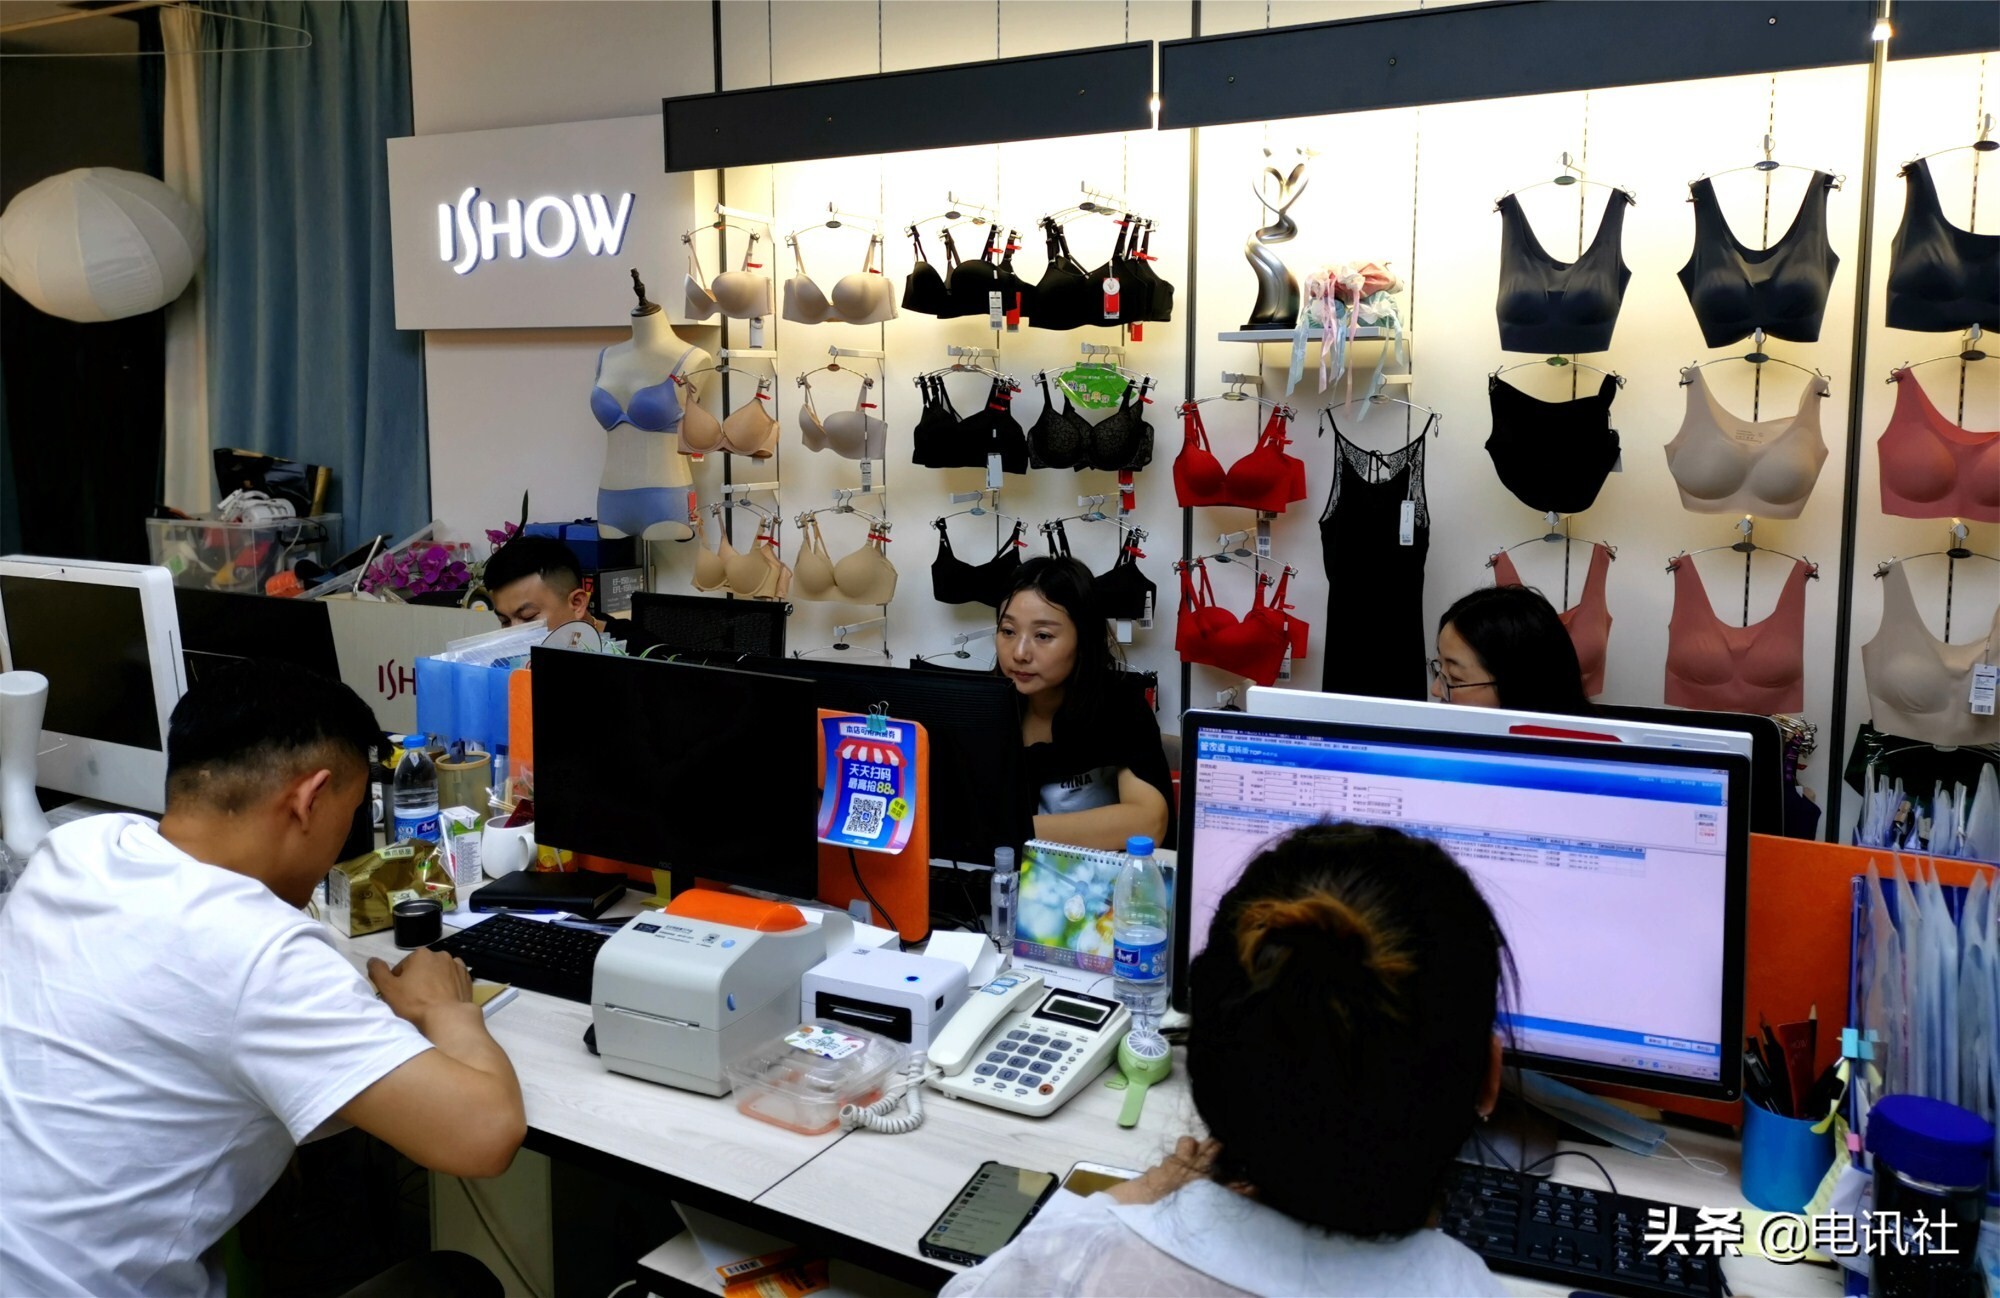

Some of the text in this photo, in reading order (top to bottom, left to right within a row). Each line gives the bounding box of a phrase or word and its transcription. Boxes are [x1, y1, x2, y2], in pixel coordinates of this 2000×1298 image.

[438, 187, 635, 275] ISHOW
[849, 763, 891, 781] 天天扫码
